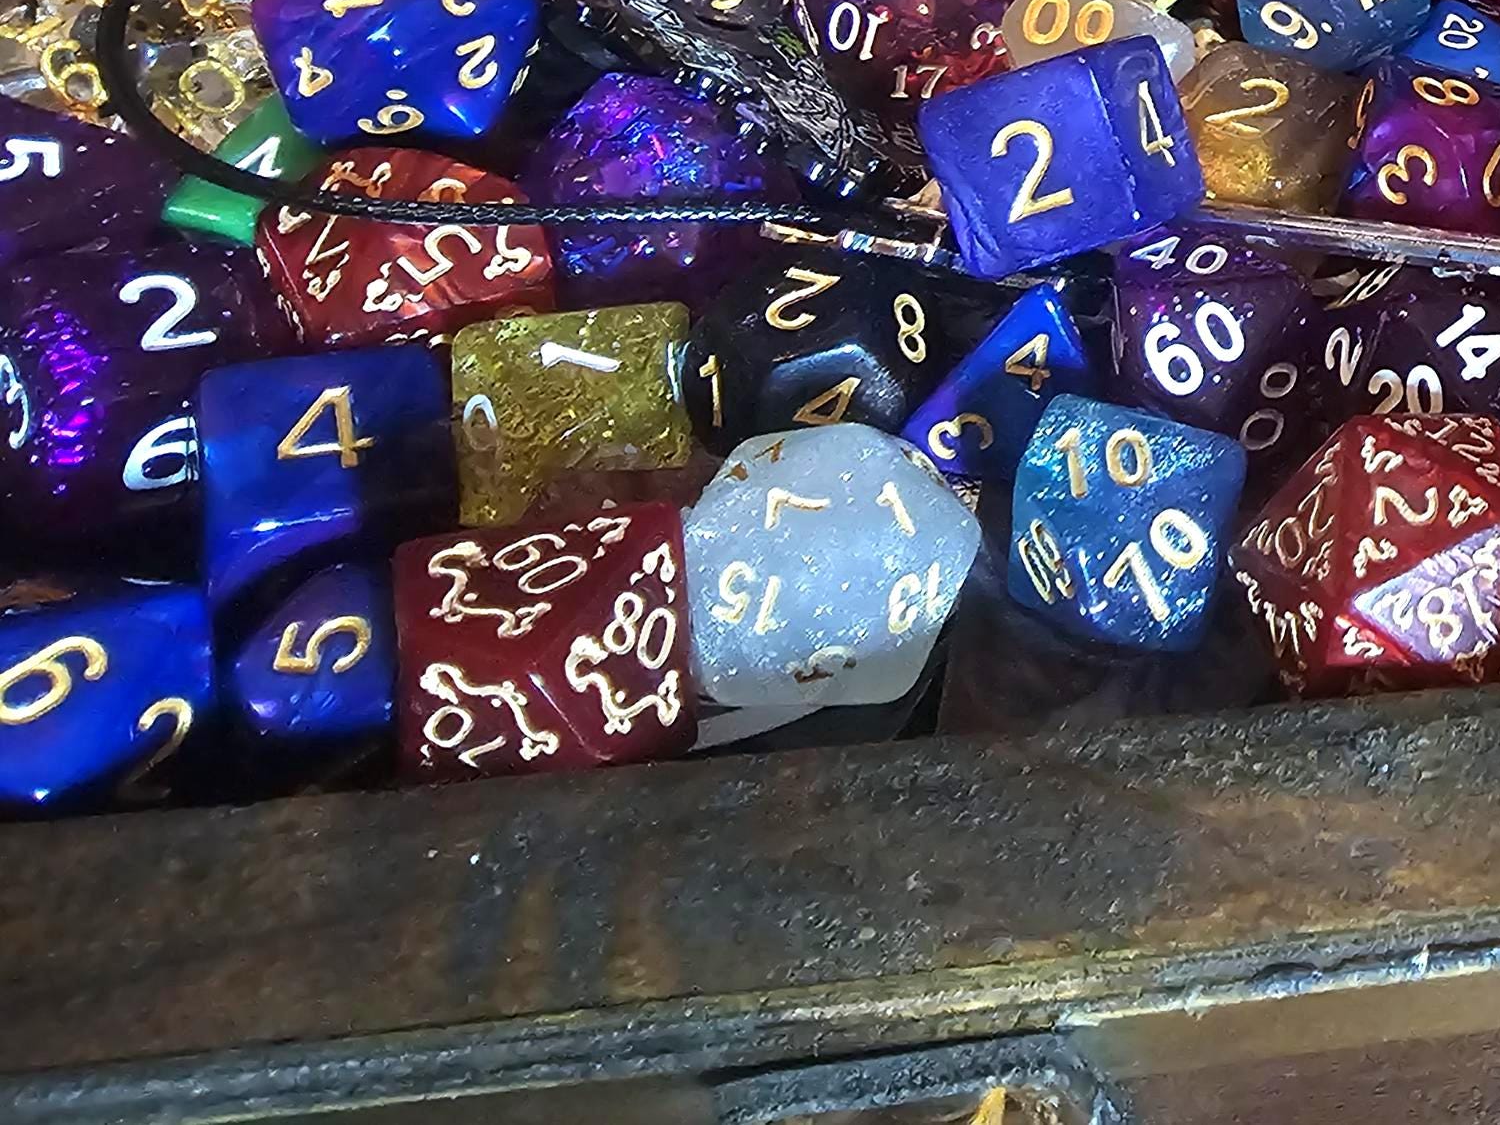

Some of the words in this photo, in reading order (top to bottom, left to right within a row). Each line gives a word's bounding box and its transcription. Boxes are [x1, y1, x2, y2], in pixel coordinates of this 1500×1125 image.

[828, 2, 888, 59] 10
[1438, 13, 1483, 49] 20
[1413, 77, 1480, 106] 8
[2, 139, 61, 177] 5
[991, 120, 1074, 224] 2
[1378, 144, 1437, 204] 3
[1130, 237, 1228, 274] 40
[120, 275, 217, 351] 2
[766, 267, 840, 330] 2
[895, 293, 926, 362] 8
[1005, 334, 1051, 390] 4
[1145, 302, 1244, 397] 60
[700, 355, 723, 428] 1
[1368, 364, 1443, 414] 20
[123, 417, 199, 491] 6
[278, 384, 375, 468] 4
[928, 413, 993, 459] 3
[1054, 427, 1152, 498] 10
[1374, 485, 1439, 526] 2
[495, 534, 587, 595] 60
[1105, 508, 1209, 590] 70
[711, 561, 781, 635] 15
[273, 616, 372, 673] 5
[604, 592, 677, 669] 80
[122, 698, 193, 799] 2
